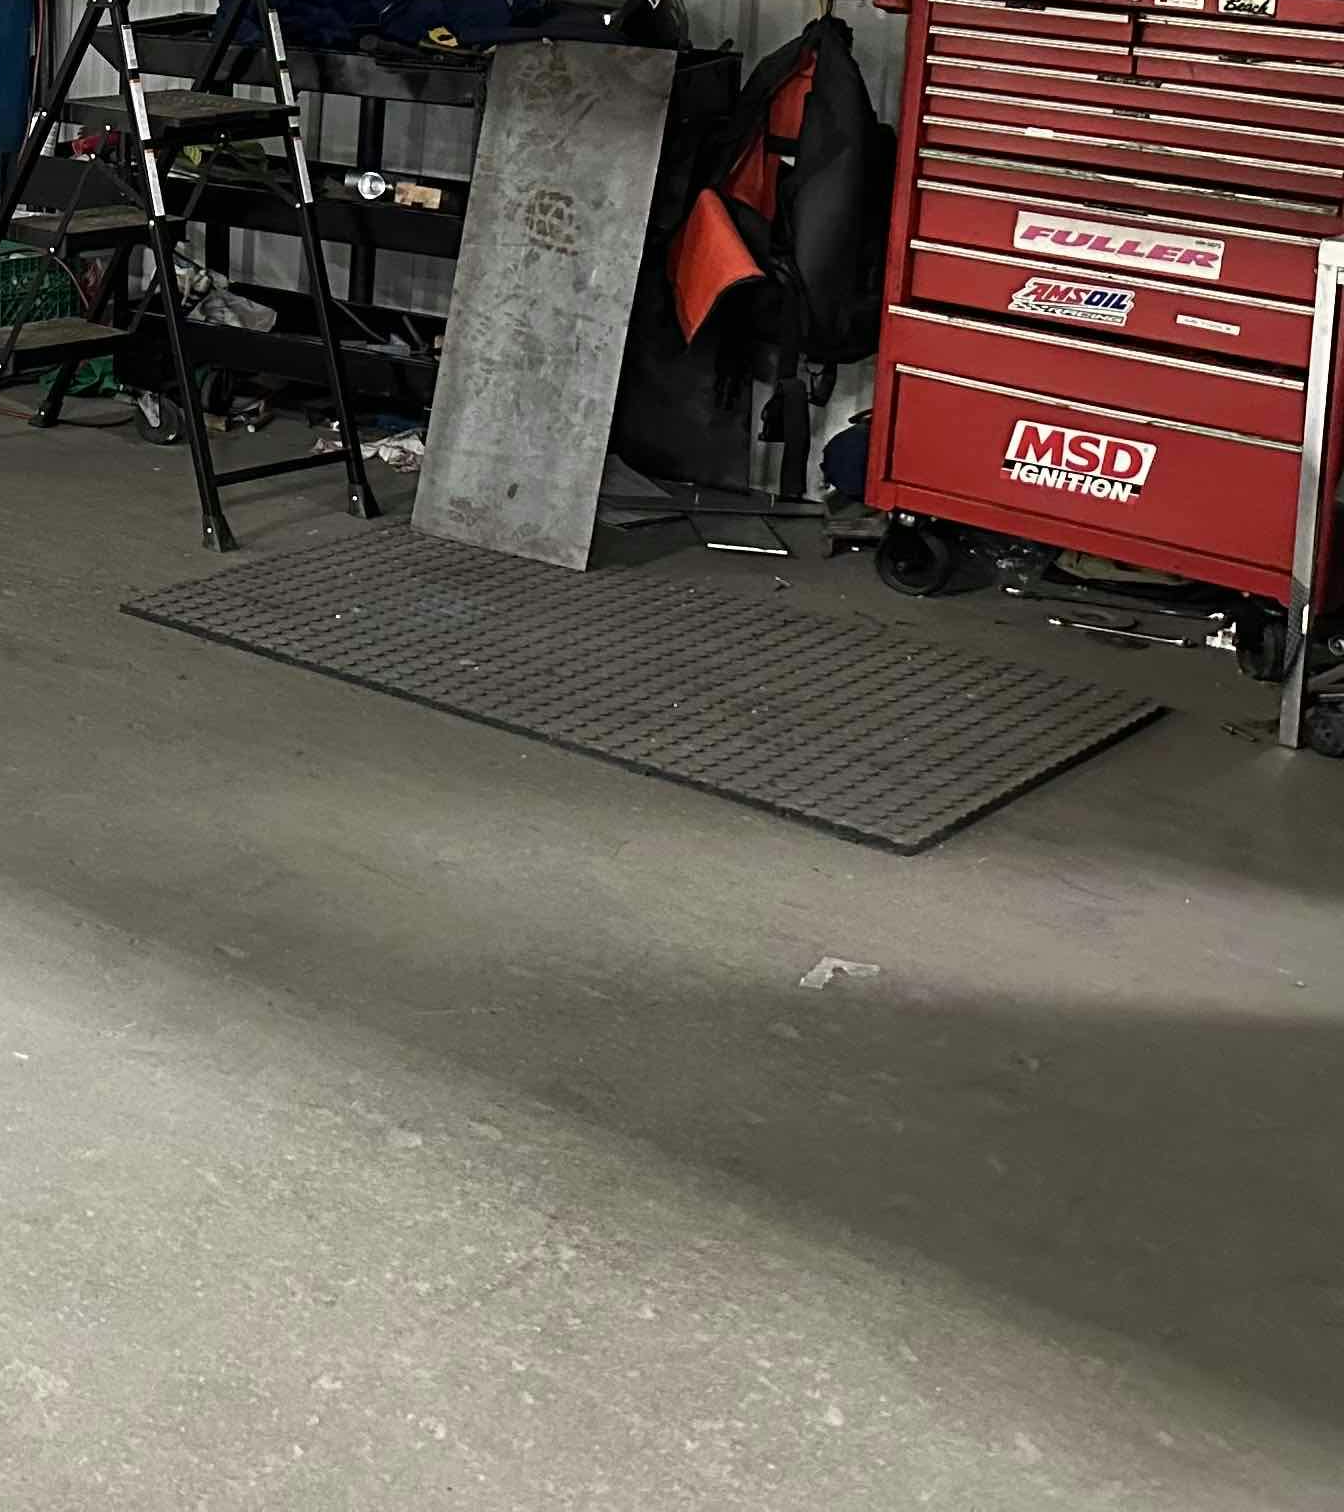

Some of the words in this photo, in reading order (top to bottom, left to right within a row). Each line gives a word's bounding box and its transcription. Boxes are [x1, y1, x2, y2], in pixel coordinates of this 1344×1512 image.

[1019, 224, 1219, 269] FULLER
[1023, 282, 1129, 310] AMSOIL
[1014, 425, 1143, 479] MSD
[1011, 462, 1133, 503] IGNITION
